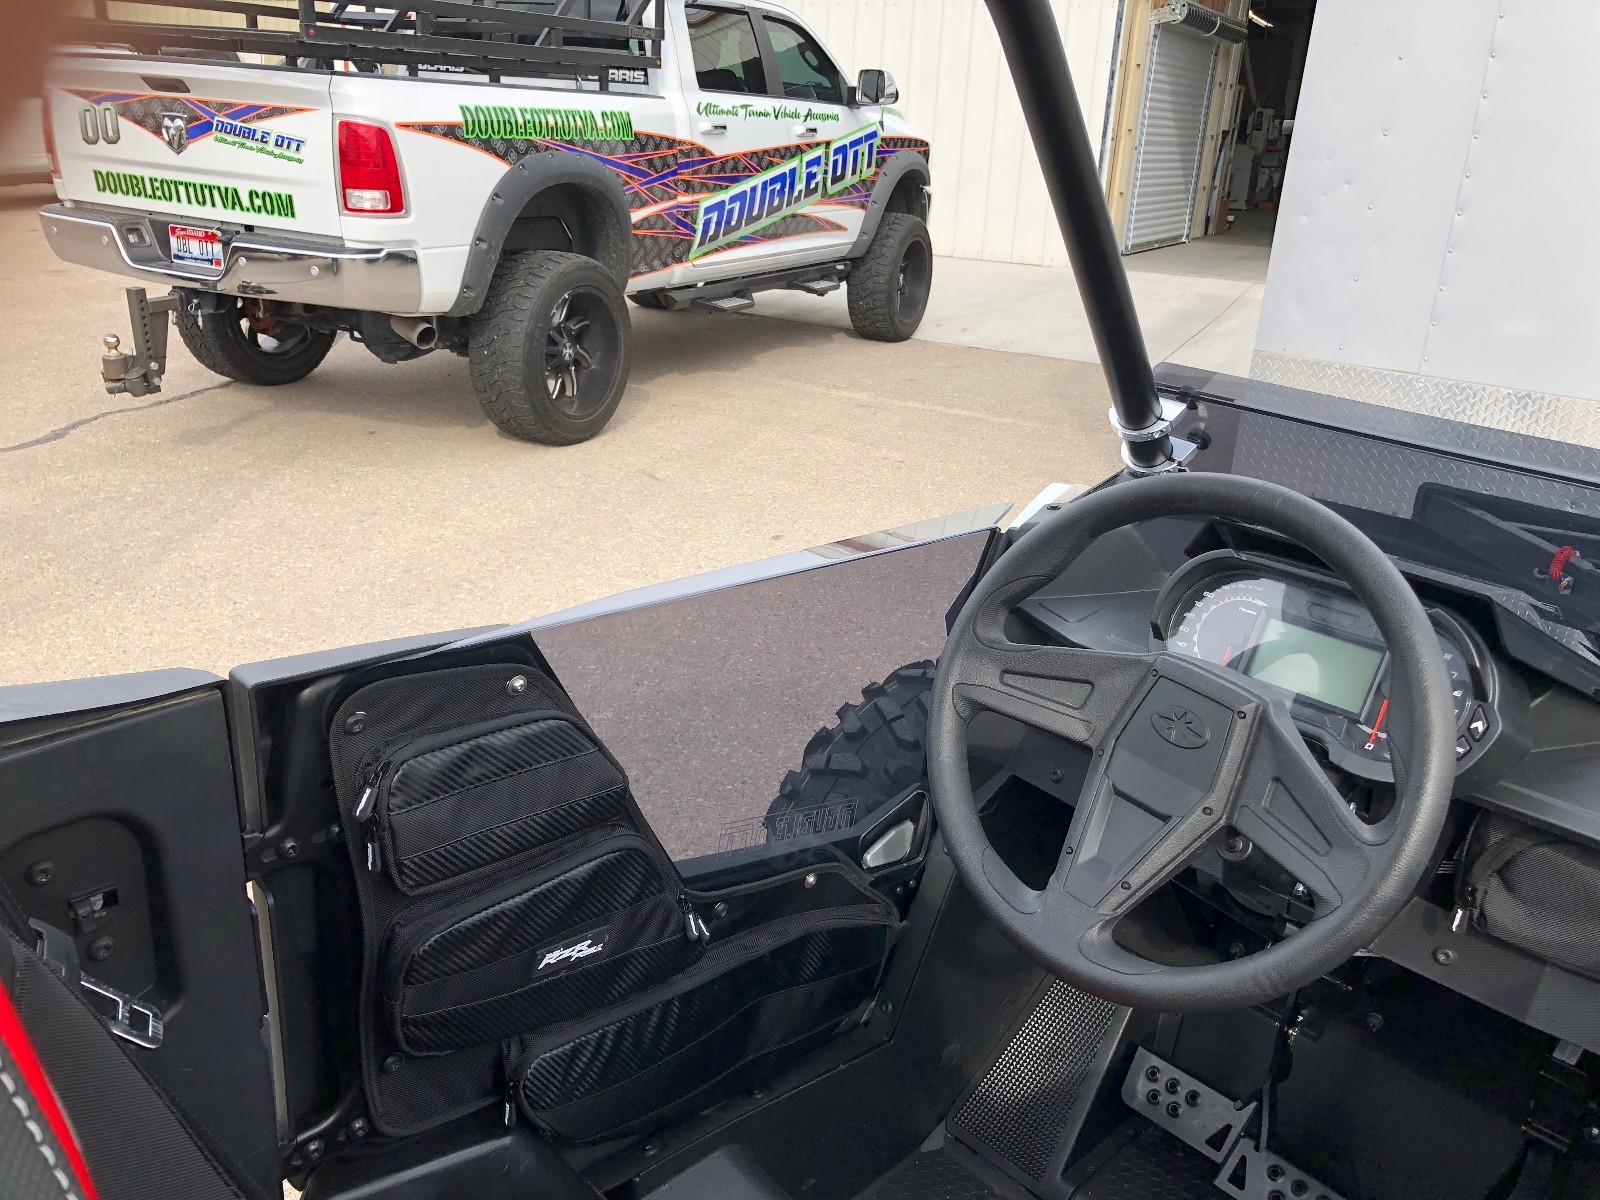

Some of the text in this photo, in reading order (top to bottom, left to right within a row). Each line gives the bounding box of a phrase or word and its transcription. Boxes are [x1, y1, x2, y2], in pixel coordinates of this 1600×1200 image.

[459, 104, 634, 140] DOUBLEOTTUTVA.COM
[697, 101, 840, 122] Ultimate Terrain Vehicle Accessories
[215, 119, 305, 152] DOUBLE OTT
[92, 169, 297, 219] DOUBLEOTTUTVA.COM
[696, 129, 878, 249] DOUBLE OTT
[177, 236, 193, 254] DBL
